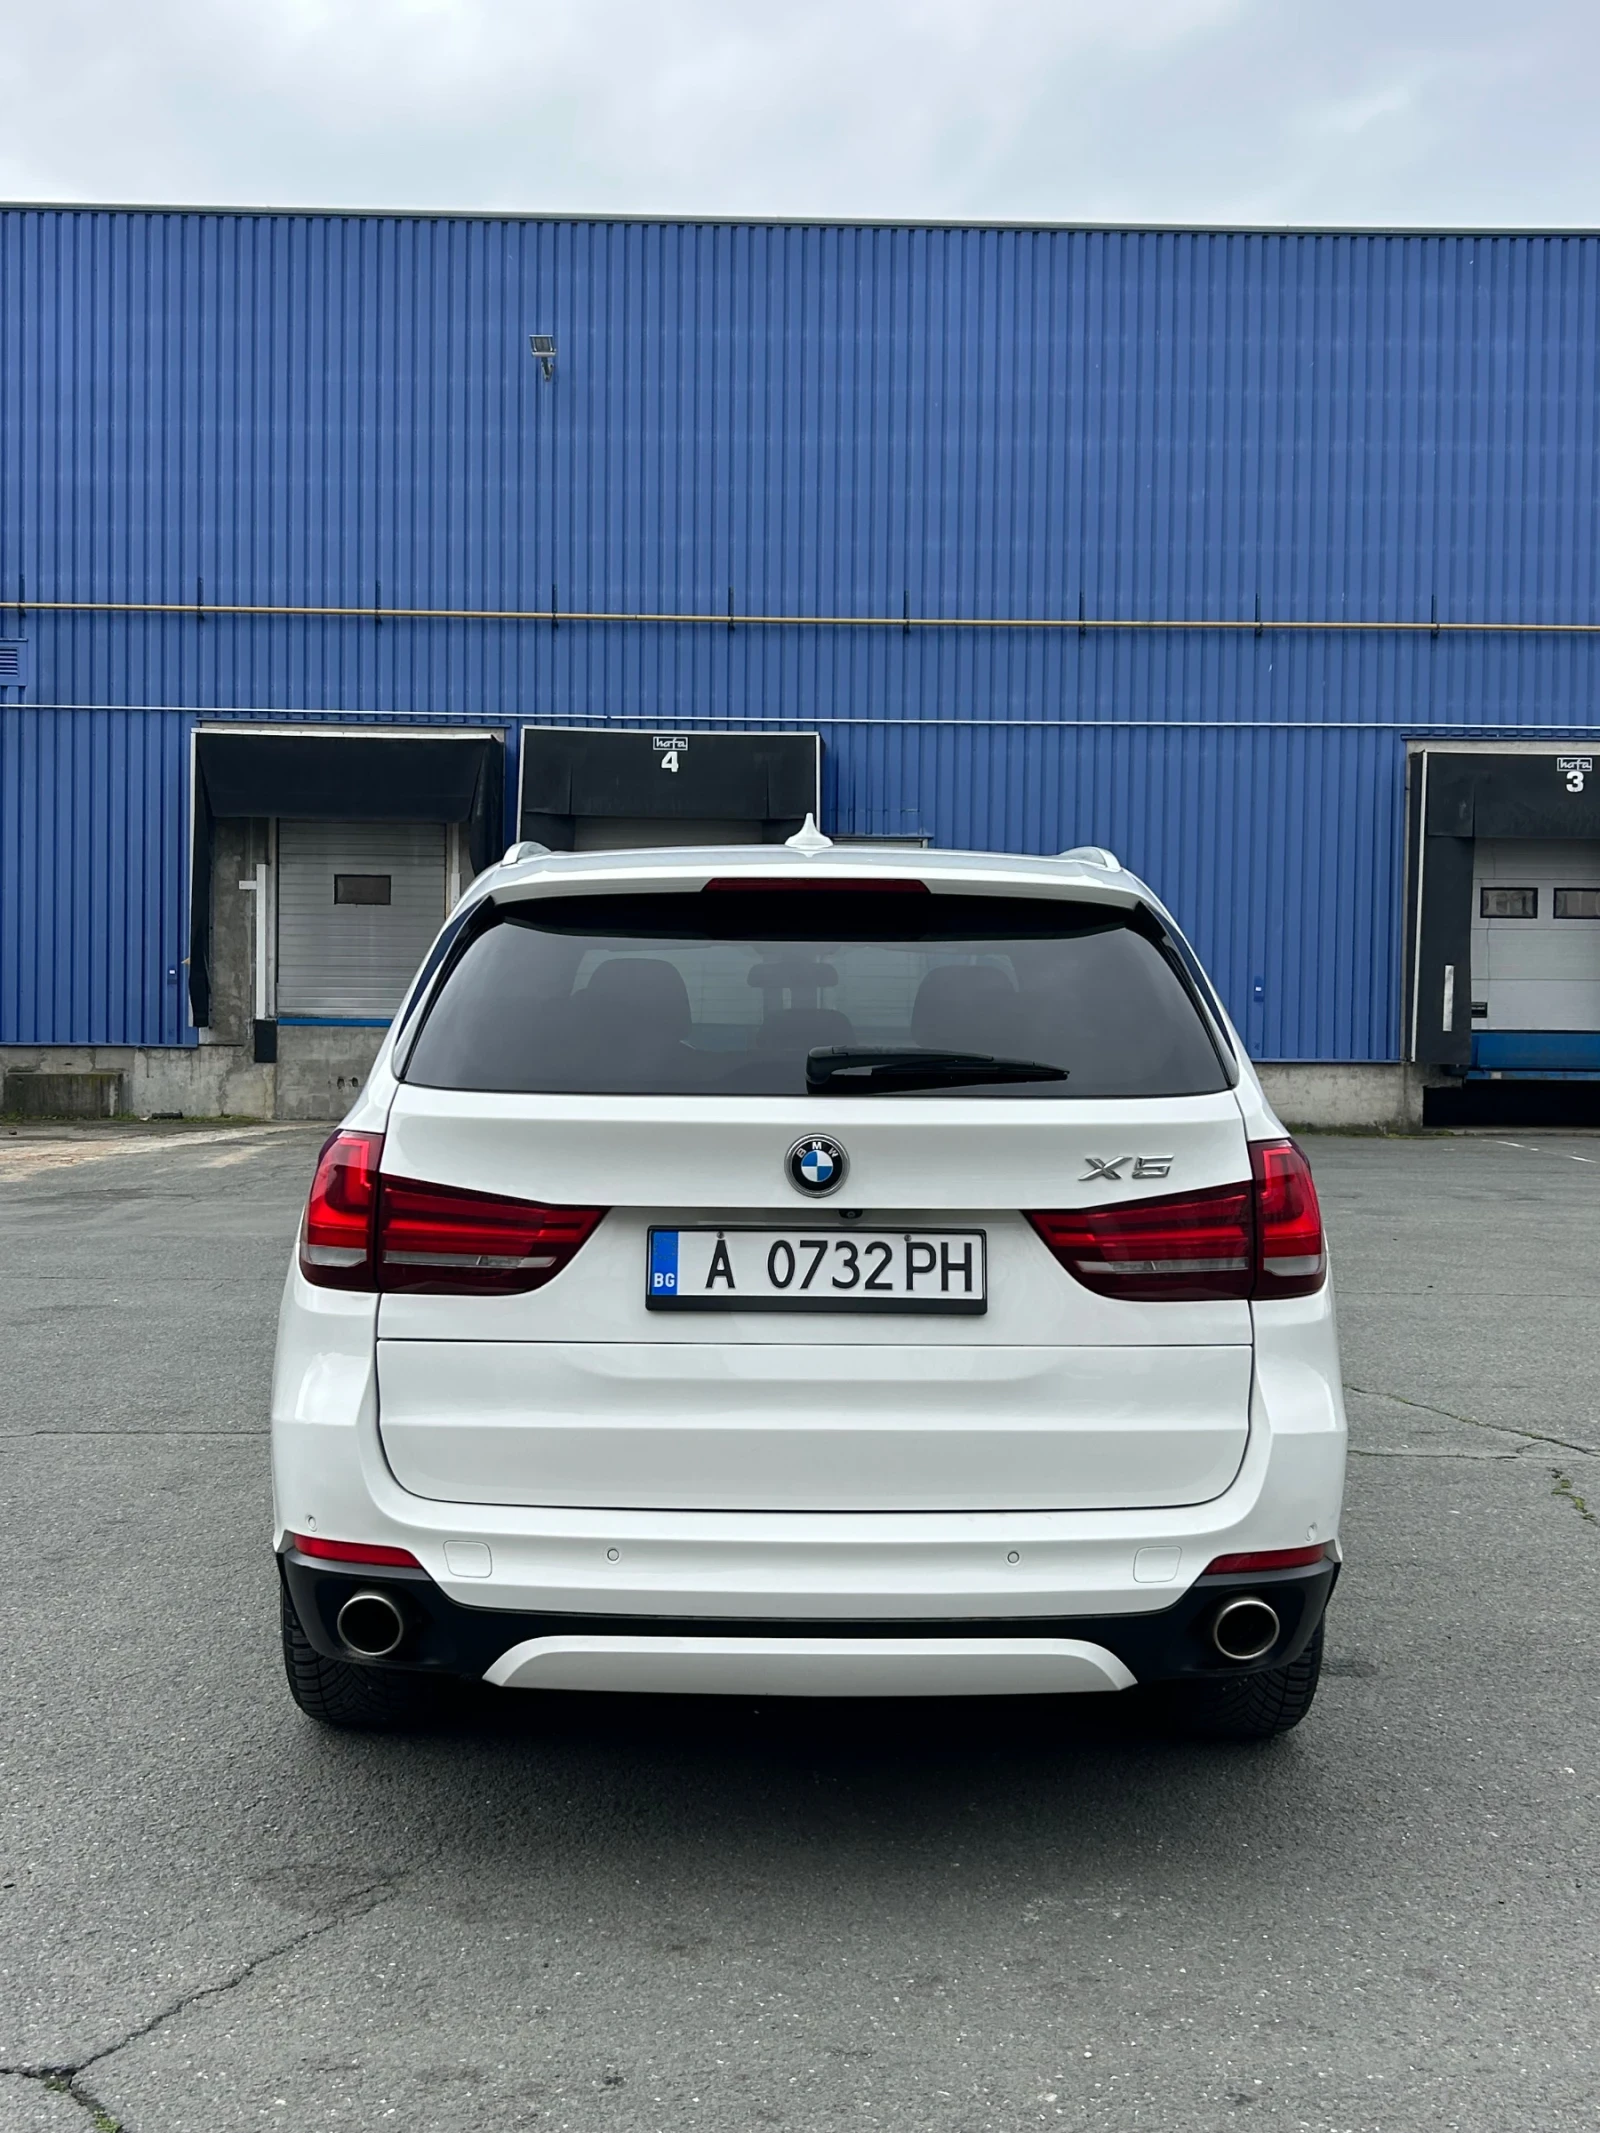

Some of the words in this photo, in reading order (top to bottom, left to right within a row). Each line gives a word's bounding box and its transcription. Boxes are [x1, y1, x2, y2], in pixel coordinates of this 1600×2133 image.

[661, 751, 678, 772] 4
[1566, 771, 1584, 792] 3
[796, 1141, 839, 1158] BMW
[1078, 1155, 1174, 1181] X5
[705, 1239, 736, 1288] A
[653, 1273, 675, 1287] BG
